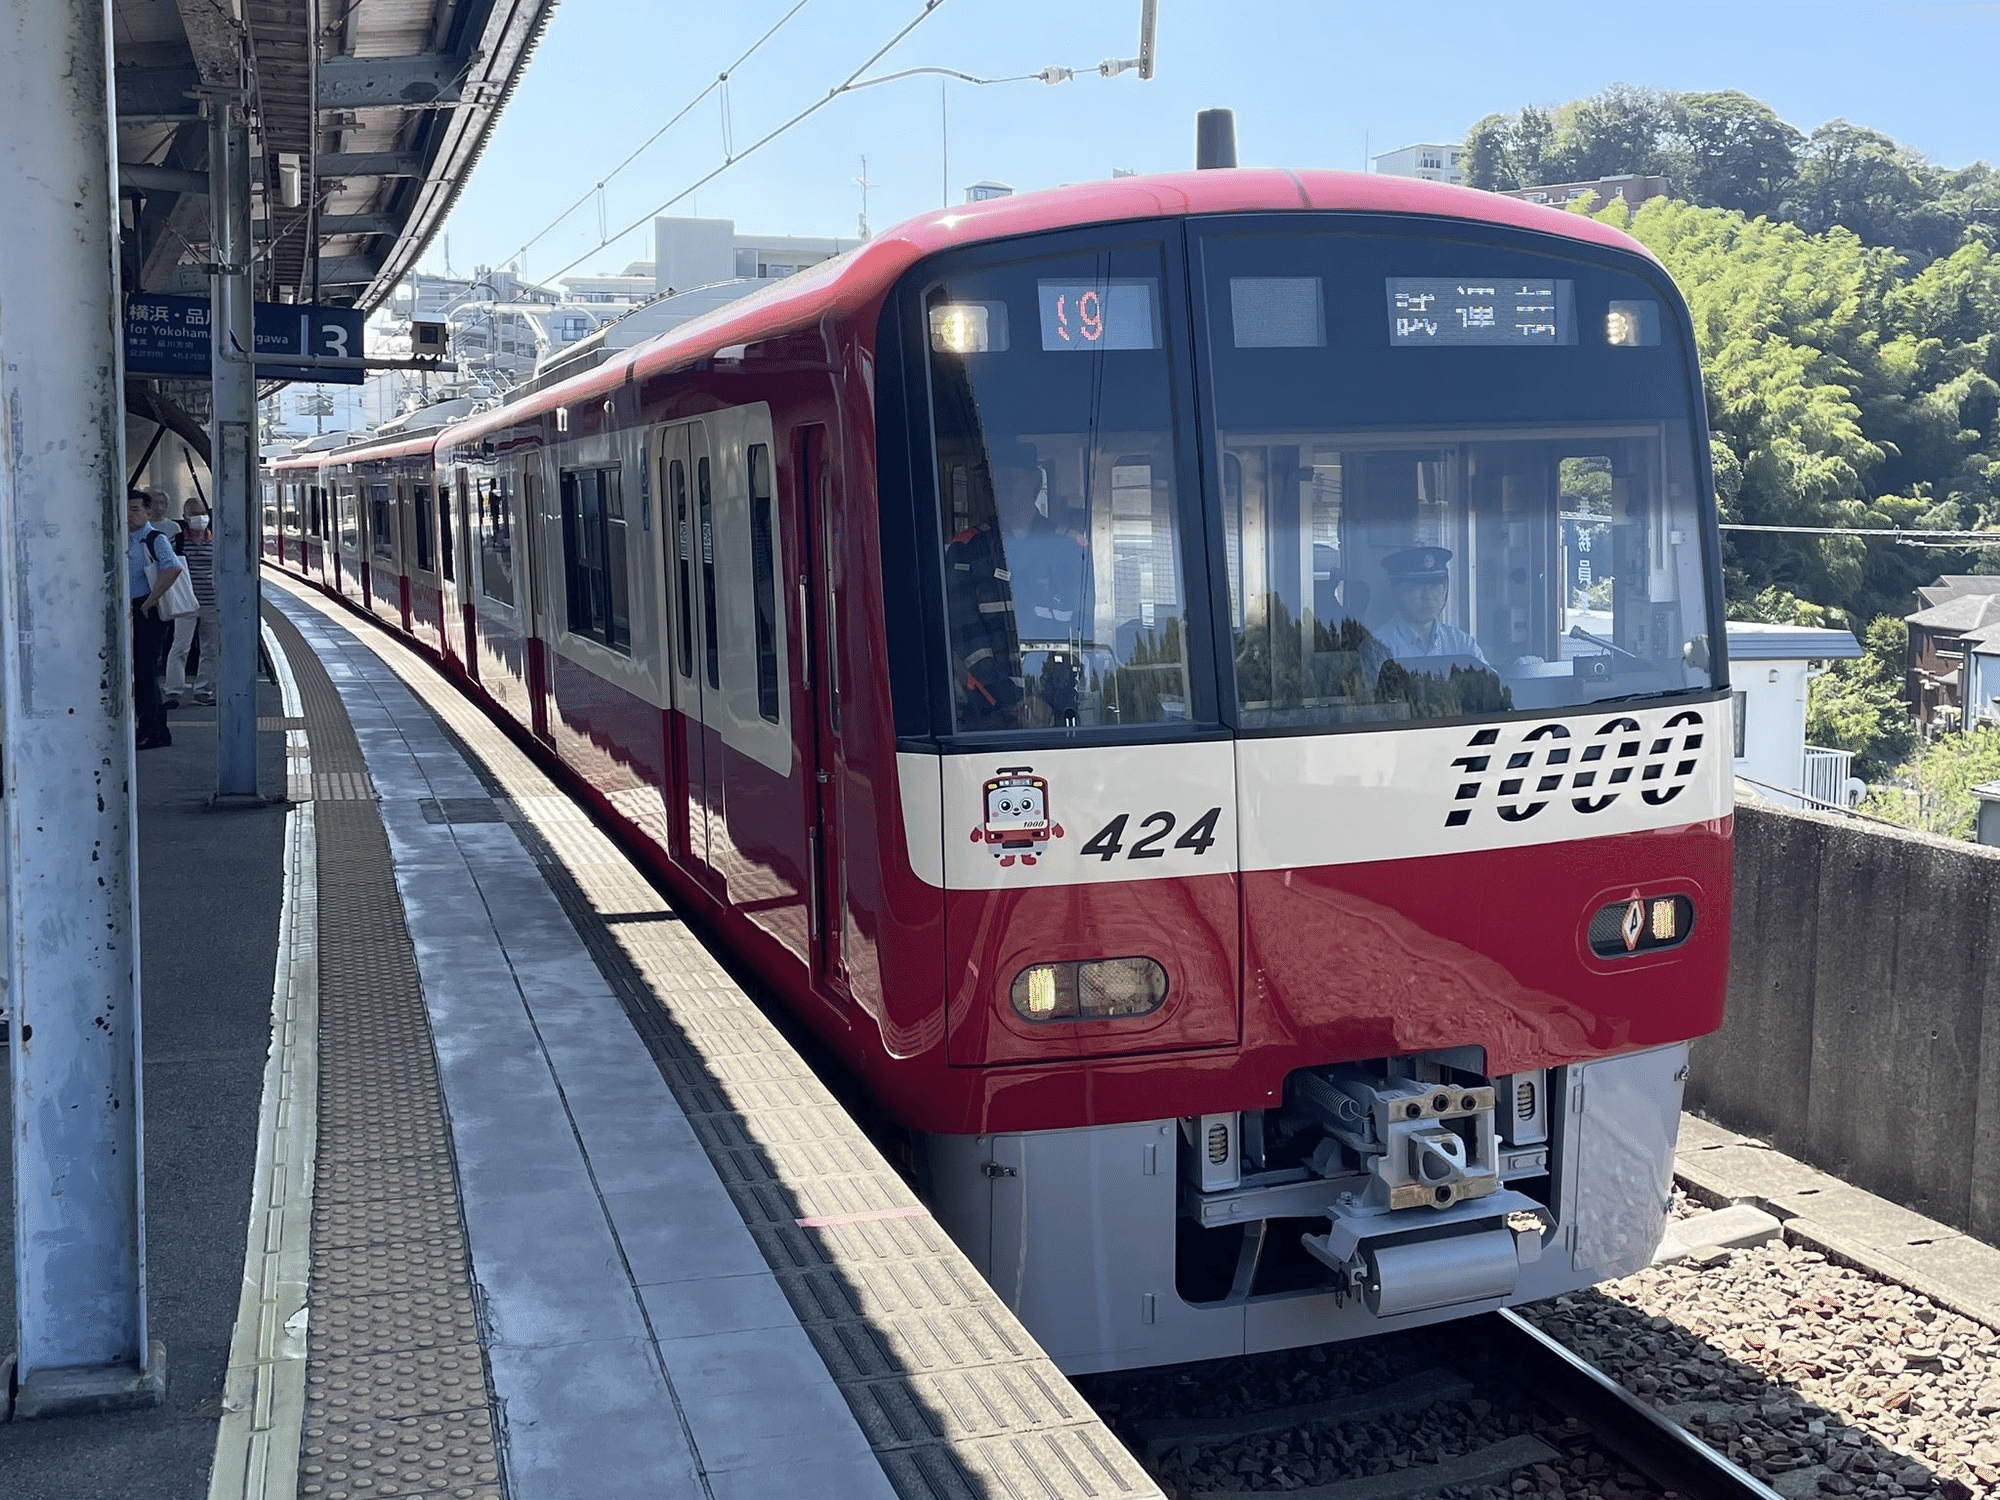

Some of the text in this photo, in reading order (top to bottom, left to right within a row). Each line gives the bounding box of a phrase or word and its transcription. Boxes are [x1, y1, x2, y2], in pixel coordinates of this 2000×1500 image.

[130, 323, 148, 335] for
[152, 325, 212, 340] Yokoham
[321, 324, 348, 358] 3
[1444, 711, 1703, 827] 1000
[1022, 820, 1045, 828] 1000
[1080, 807, 1222, 862] 424
